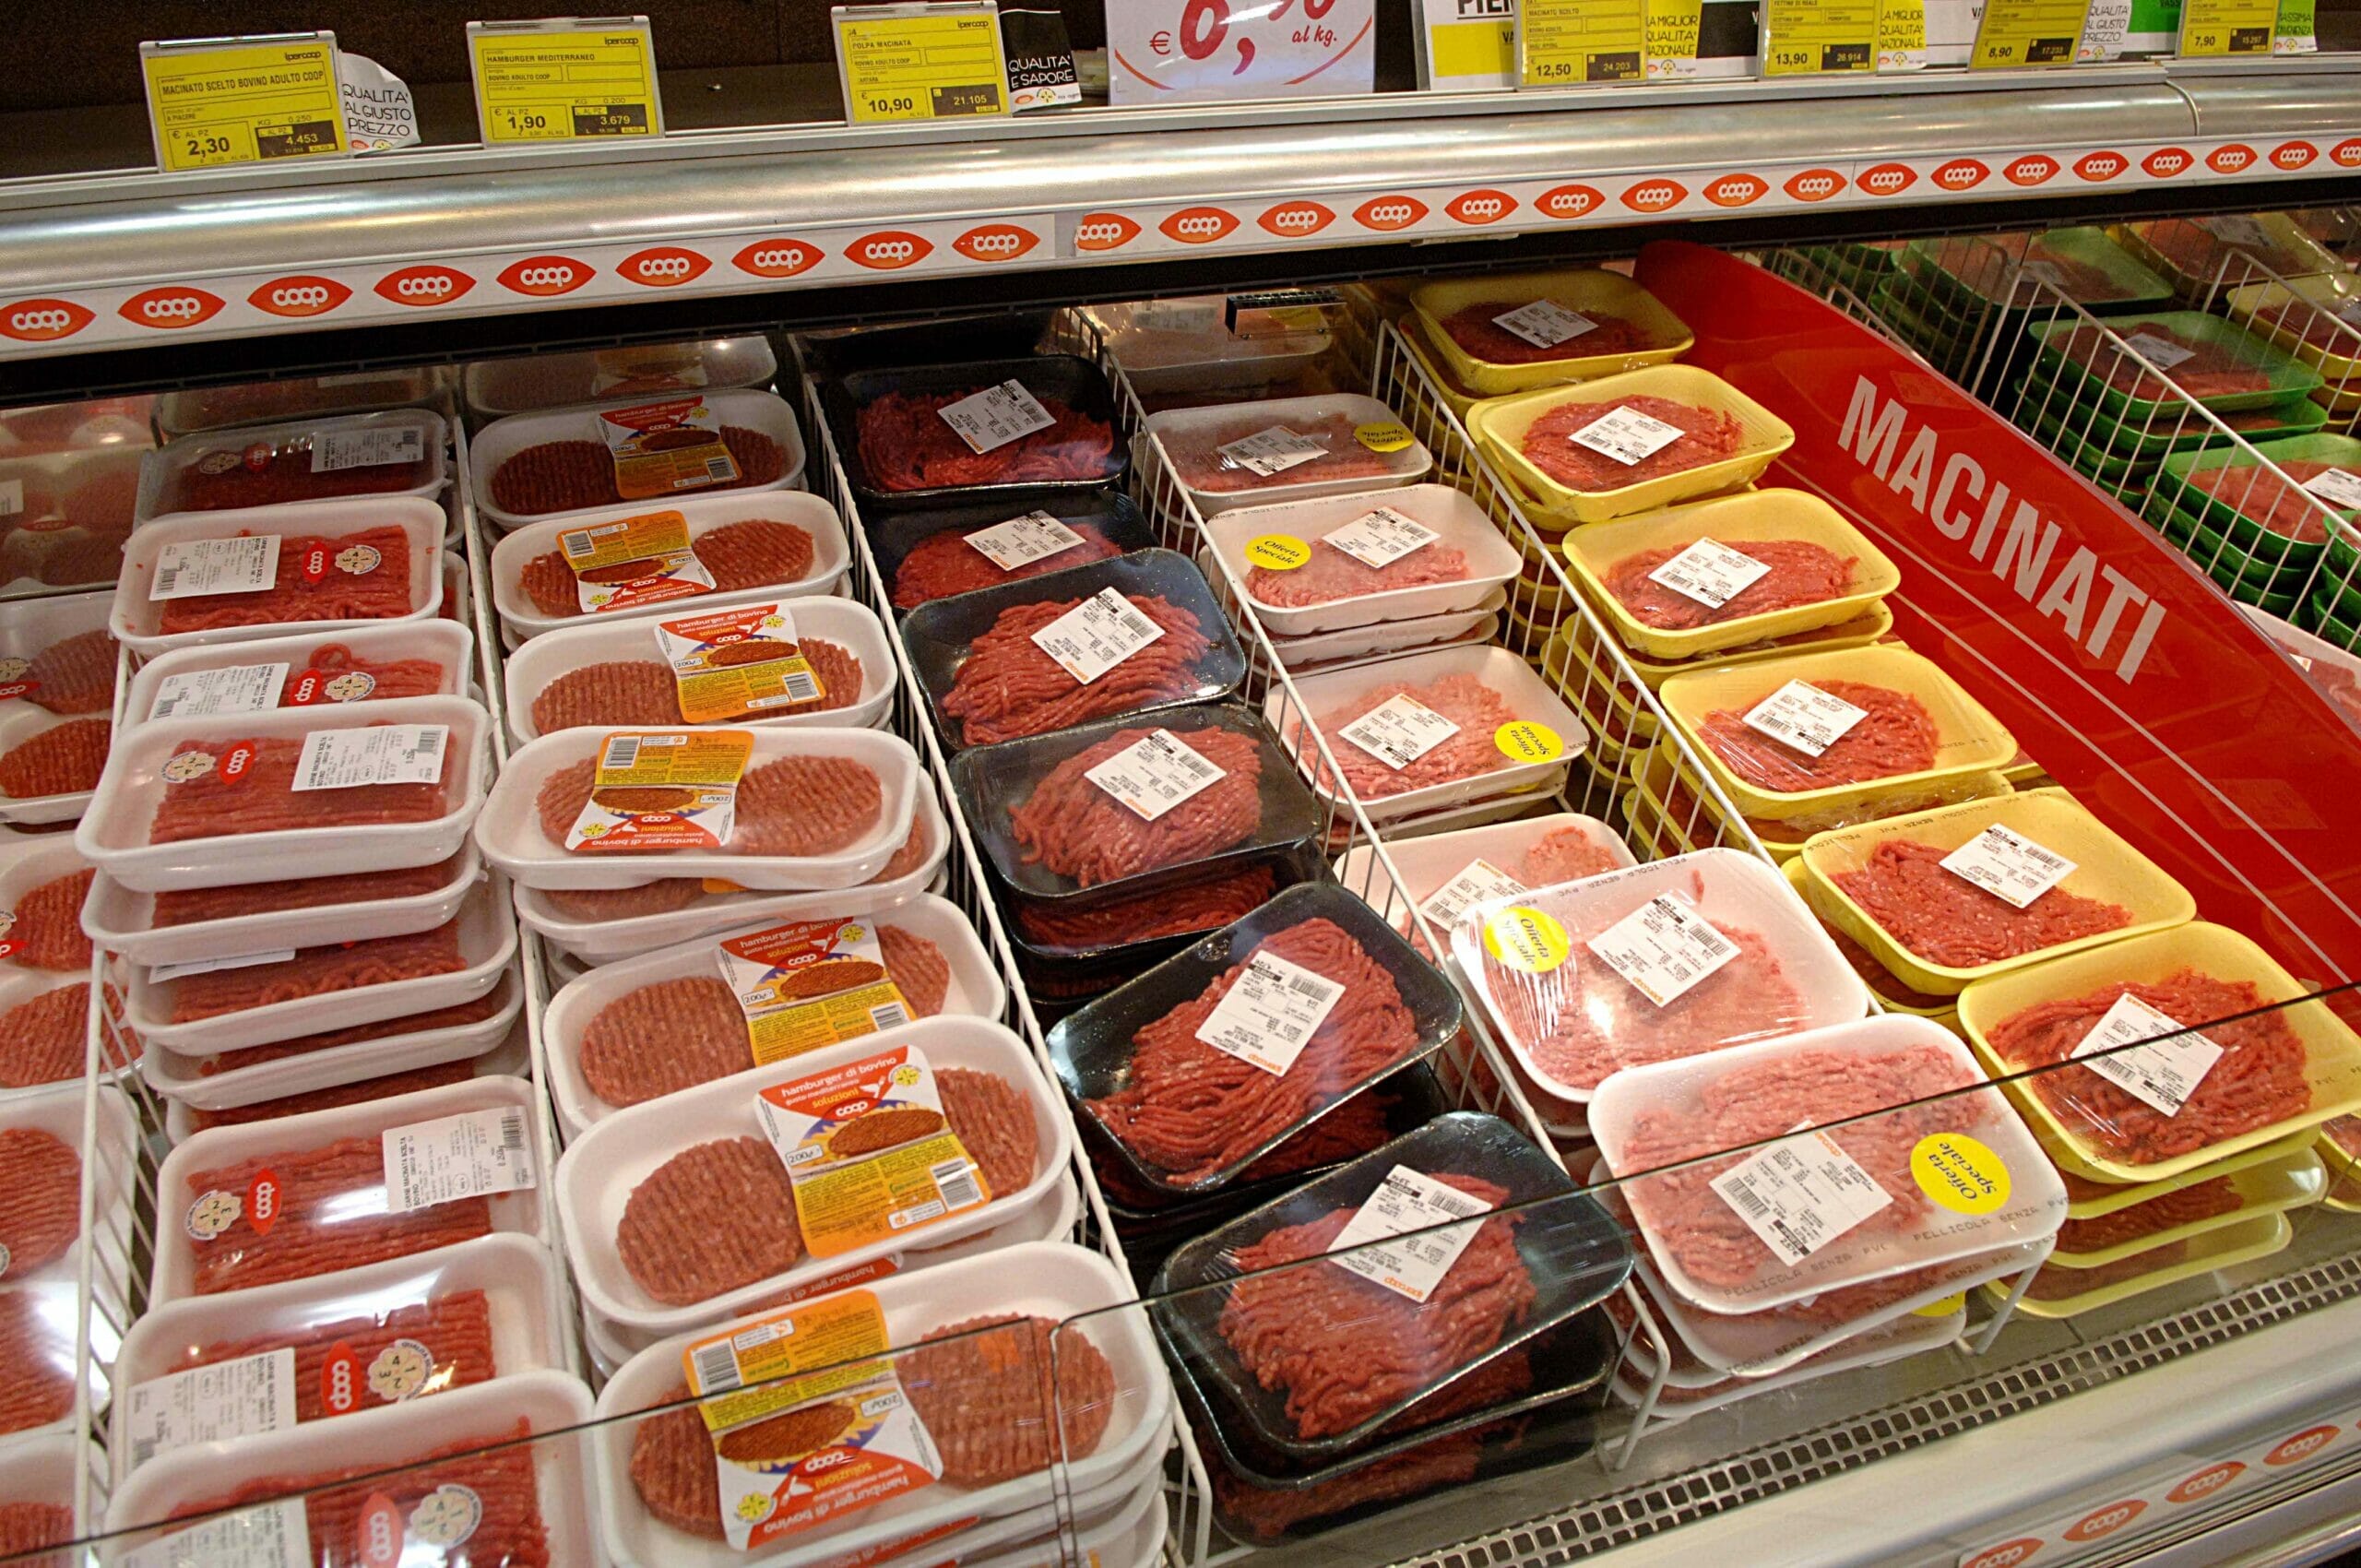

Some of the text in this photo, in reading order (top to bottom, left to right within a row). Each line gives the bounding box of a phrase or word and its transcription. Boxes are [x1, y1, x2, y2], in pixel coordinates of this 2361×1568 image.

[1657, 15, 1698, 28] MIGLIOR
[1892, 9, 1923, 21] MIGLIOR
[2096, 19, 2126, 29] GIUSTO
[1292, 24, 1337, 47] al kg.
[1880, 25, 1923, 35] QUALITA'
[877, 40, 911, 48] MACINATA
[1149, 30, 1171, 54] €
[2195, 36, 2215, 49] 7,90
[538, 53, 595, 62] MEDITERRANEO
[1776, 53, 1808, 66] 13,90
[1988, 47, 2012, 59] 8,90
[1008, 55, 1071, 73] QUALITA'
[1536, 64, 1571, 77] 12,50
[162, 70, 324, 95] MACINATO SCELTO BOVINO ADULTO COOP
[1011, 68, 1074, 89] E SAPORE
[342, 84, 409, 104] QUALITA'
[953, 94, 987, 106] 21.105
[345, 101, 411, 121] AL GIUSTO
[869, 98, 912, 113] 10,90
[348, 117, 409, 137] PREZZO
[508, 115, 546, 132] 1,90
[600, 115, 631, 125] 3.679
[172, 131, 181, 139] €
[286, 134, 318, 146] 4.453
[187, 137, 230, 158] 2,30
[2280, 148, 2308, 162] coop
[2085, 160, 2117, 174] coop
[2153, 155, 2182, 170] coop
[2217, 151, 2247, 166] coop
[1870, 172, 1904, 188] coop
[1945, 167, 1977, 184] coop
[2016, 163, 2047, 178] coop
[1718, 183, 1754, 200] coop
[1797, 177, 1833, 194] coop
[1550, 194, 1589, 211] coop
[1636, 187, 1673, 205] coop
[1370, 205, 1412, 223] coop
[1462, 198, 1501, 217] coop
[1178, 216, 1222, 236] coop
[1275, 210, 1318, 230] coop
[865, 241, 913, 261] coop
[973, 233, 1020, 254] coop
[639, 256, 690, 278] coop
[753, 248, 803, 269] coop
[397, 276, 453, 297] coop
[520, 266, 574, 287] coop
[272, 286, 328, 307] coop
[143, 297, 201, 319] coop
[11, 309, 70, 331] coop
[648, 422, 671, 431] coop
[1836, 374, 2167, 685] MACINATI
[1253, 546, 1295, 564] Speciale
[1264, 540, 1300, 558] Offerta
[307, 551, 324, 574] coop
[632, 578, 658, 588] coop
[677, 615, 725, 630] hamburger
[738, 610, 768, 619] bovino
[699, 626, 736, 636] soluzioni
[717, 634, 742, 643] coop
[294, 678, 316, 703] coop
[1510, 730, 1535, 756] Offerta
[1521, 726, 1550, 755] Speciale
[227, 749, 250, 774] coop
[646, 837, 703, 846] hamburger
[1588, 857, 1687, 888] PELLICOLA SENZA
[740, 926, 808, 948] hamburger di
[1520, 918, 1549, 958] Offerta
[767, 943, 810, 958] soluzioni
[788, 954, 817, 966] coop
[1247, 1052, 1283, 1073] ipercoop
[781, 1057, 896, 1098] hamburger di bovino
[812, 1087, 859, 1108] soluzioni
[836, 1100, 868, 1117] coop
[399, 1136, 408, 1158] SCELTA
[1928, 1154, 1978, 1200] Offerta
[1939, 1142, 1998, 1194] Speciale
[212, 1200, 220, 1209] 2
[255, 1182, 275, 1220] coop
[404, 1187, 413, 1208] CARNE
[412, 1183, 421, 1208] BOVINO
[220, 1206, 232, 1215] 3
[1724, 1206, 2039, 1300] PELLICOLA SENZA PVC PELLICOLA SENZA
[810, 1265, 874, 1295] hamburger
[1383, 1275, 1424, 1300] ipercoop
[391, 1355, 401, 1366] 4
[379, 1370, 392, 1379] 3
[393, 1377, 403, 1389] 2
[330, 1360, 351, 1410] coop
[2281, 1432, 2323, 1456] coop
[805, 1451, 846, 1472] coop
[815, 1462, 872, 1490] soluzioni
[2184, 1468, 2228, 1495] coop
[764, 1475, 909, 1533] hamburger di bovino
[2082, 1507, 2130, 1533] coop
[371, 1511, 393, 1562] coop
[1975, 1544, 2023, 1568] coop
